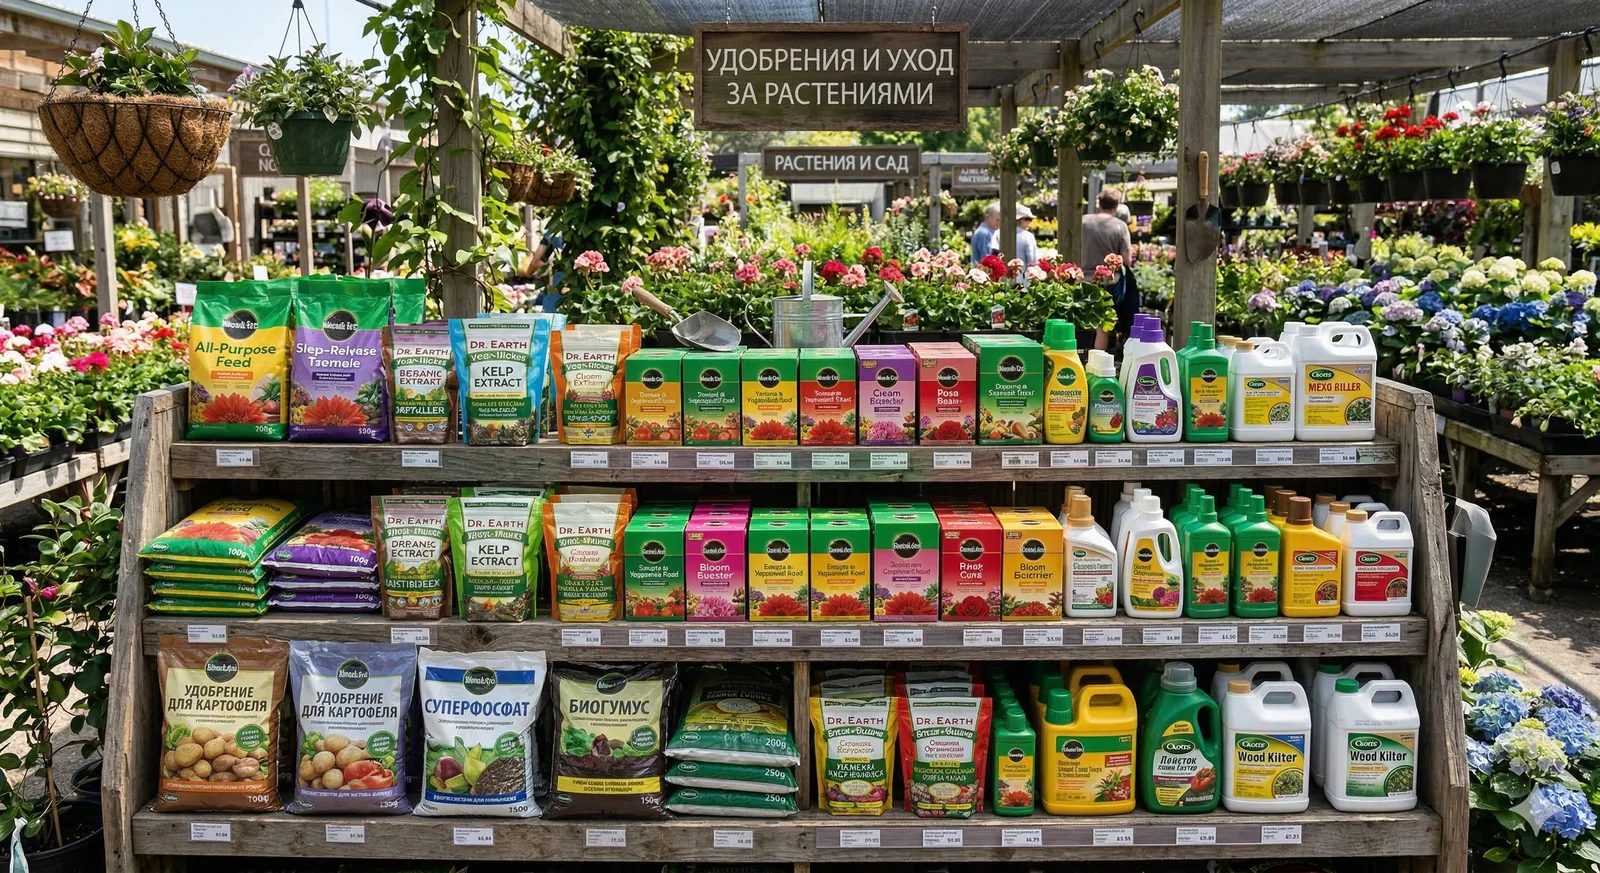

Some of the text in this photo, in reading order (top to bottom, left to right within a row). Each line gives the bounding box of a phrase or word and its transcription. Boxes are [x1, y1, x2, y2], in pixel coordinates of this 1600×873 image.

[706, 48, 954, 76] УДОБРЕНИЯ И УХОД
[726, 82, 934, 105] ЗА РАСТЕНИЯМИ
[774, 155, 909, 173] РАСТЕНИЯ И САД
[195, 341, 276, 357] All-Purpose
[470, 340, 527, 349] DR. EARTH
[415, 348, 448, 356] EARTH
[216, 356, 252, 368] Feed
[482, 366, 514, 377] KELP
[474, 378, 522, 387] EXTRACT
[468, 519, 524, 528] DR. EARTH
[228, 547, 247, 559] 100g
[478, 545, 510, 555] KELP
[350, 555, 369, 564] 100g
[700, 563, 730, 571] Bloom
[184, 684, 254, 698] УДОБРЕНИЕ
[316, 692, 384, 704] УДОБРЕНИЕ
[168, 698, 268, 712] ДЛЯ КАРТОФЕЛЯ
[424, 698, 530, 716] СУПЕРФОСФАТ
[569, 698, 650, 715] БИОГУМУС
[302, 705, 398, 718] ДЛЯ КАРТОФЕЛЯ
[828, 716, 884, 725] DR. EARTH
[916, 716, 973, 725] DR. EARTH
[1238, 752, 1297, 762] Wood Kilter
[1380, 751, 1407, 761] Kilter
[764, 768, 786, 780] 250g
[764, 794, 786, 804] 250g
